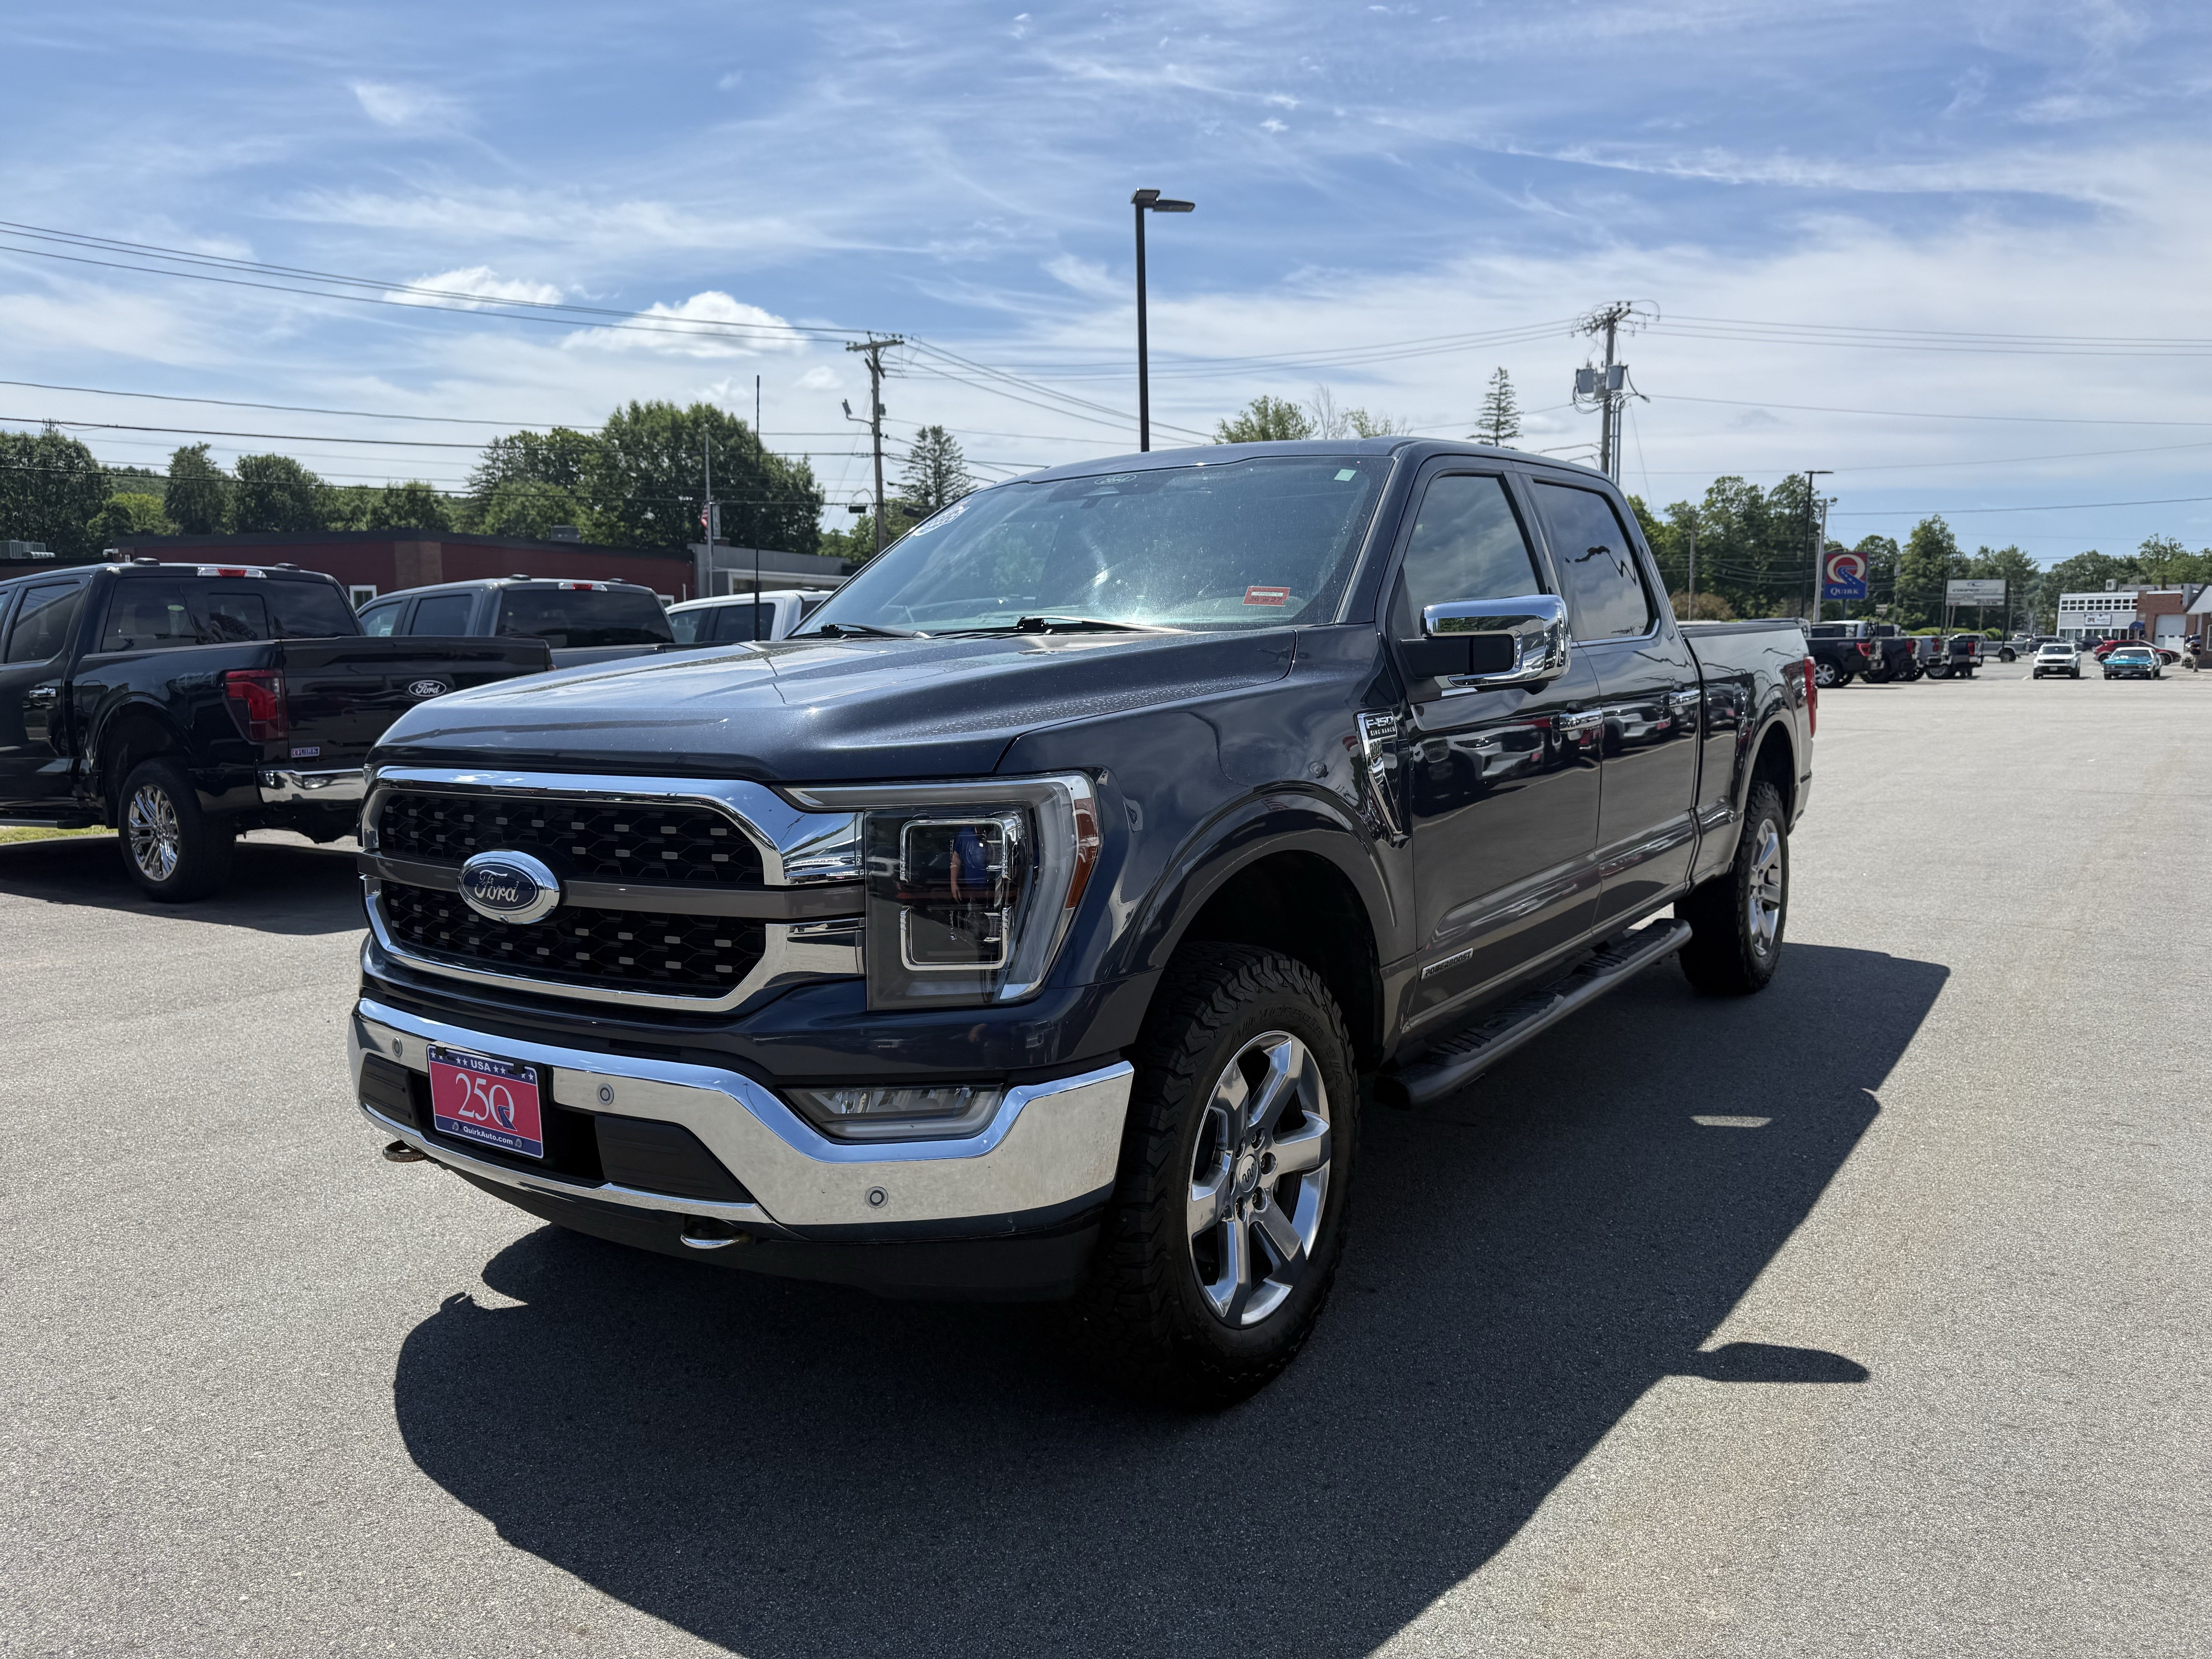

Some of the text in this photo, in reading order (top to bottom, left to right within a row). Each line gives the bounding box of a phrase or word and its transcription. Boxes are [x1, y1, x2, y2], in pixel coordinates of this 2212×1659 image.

[416, 682, 440, 694] Ford
[1365, 716, 1393, 729] F-150
[474, 869, 520, 903] Ford
[1425, 951, 1472, 977] POWERBOOST
[470, 1060, 491, 1072] USA
[463, 1126, 513, 1145] QuirkAuto.com
